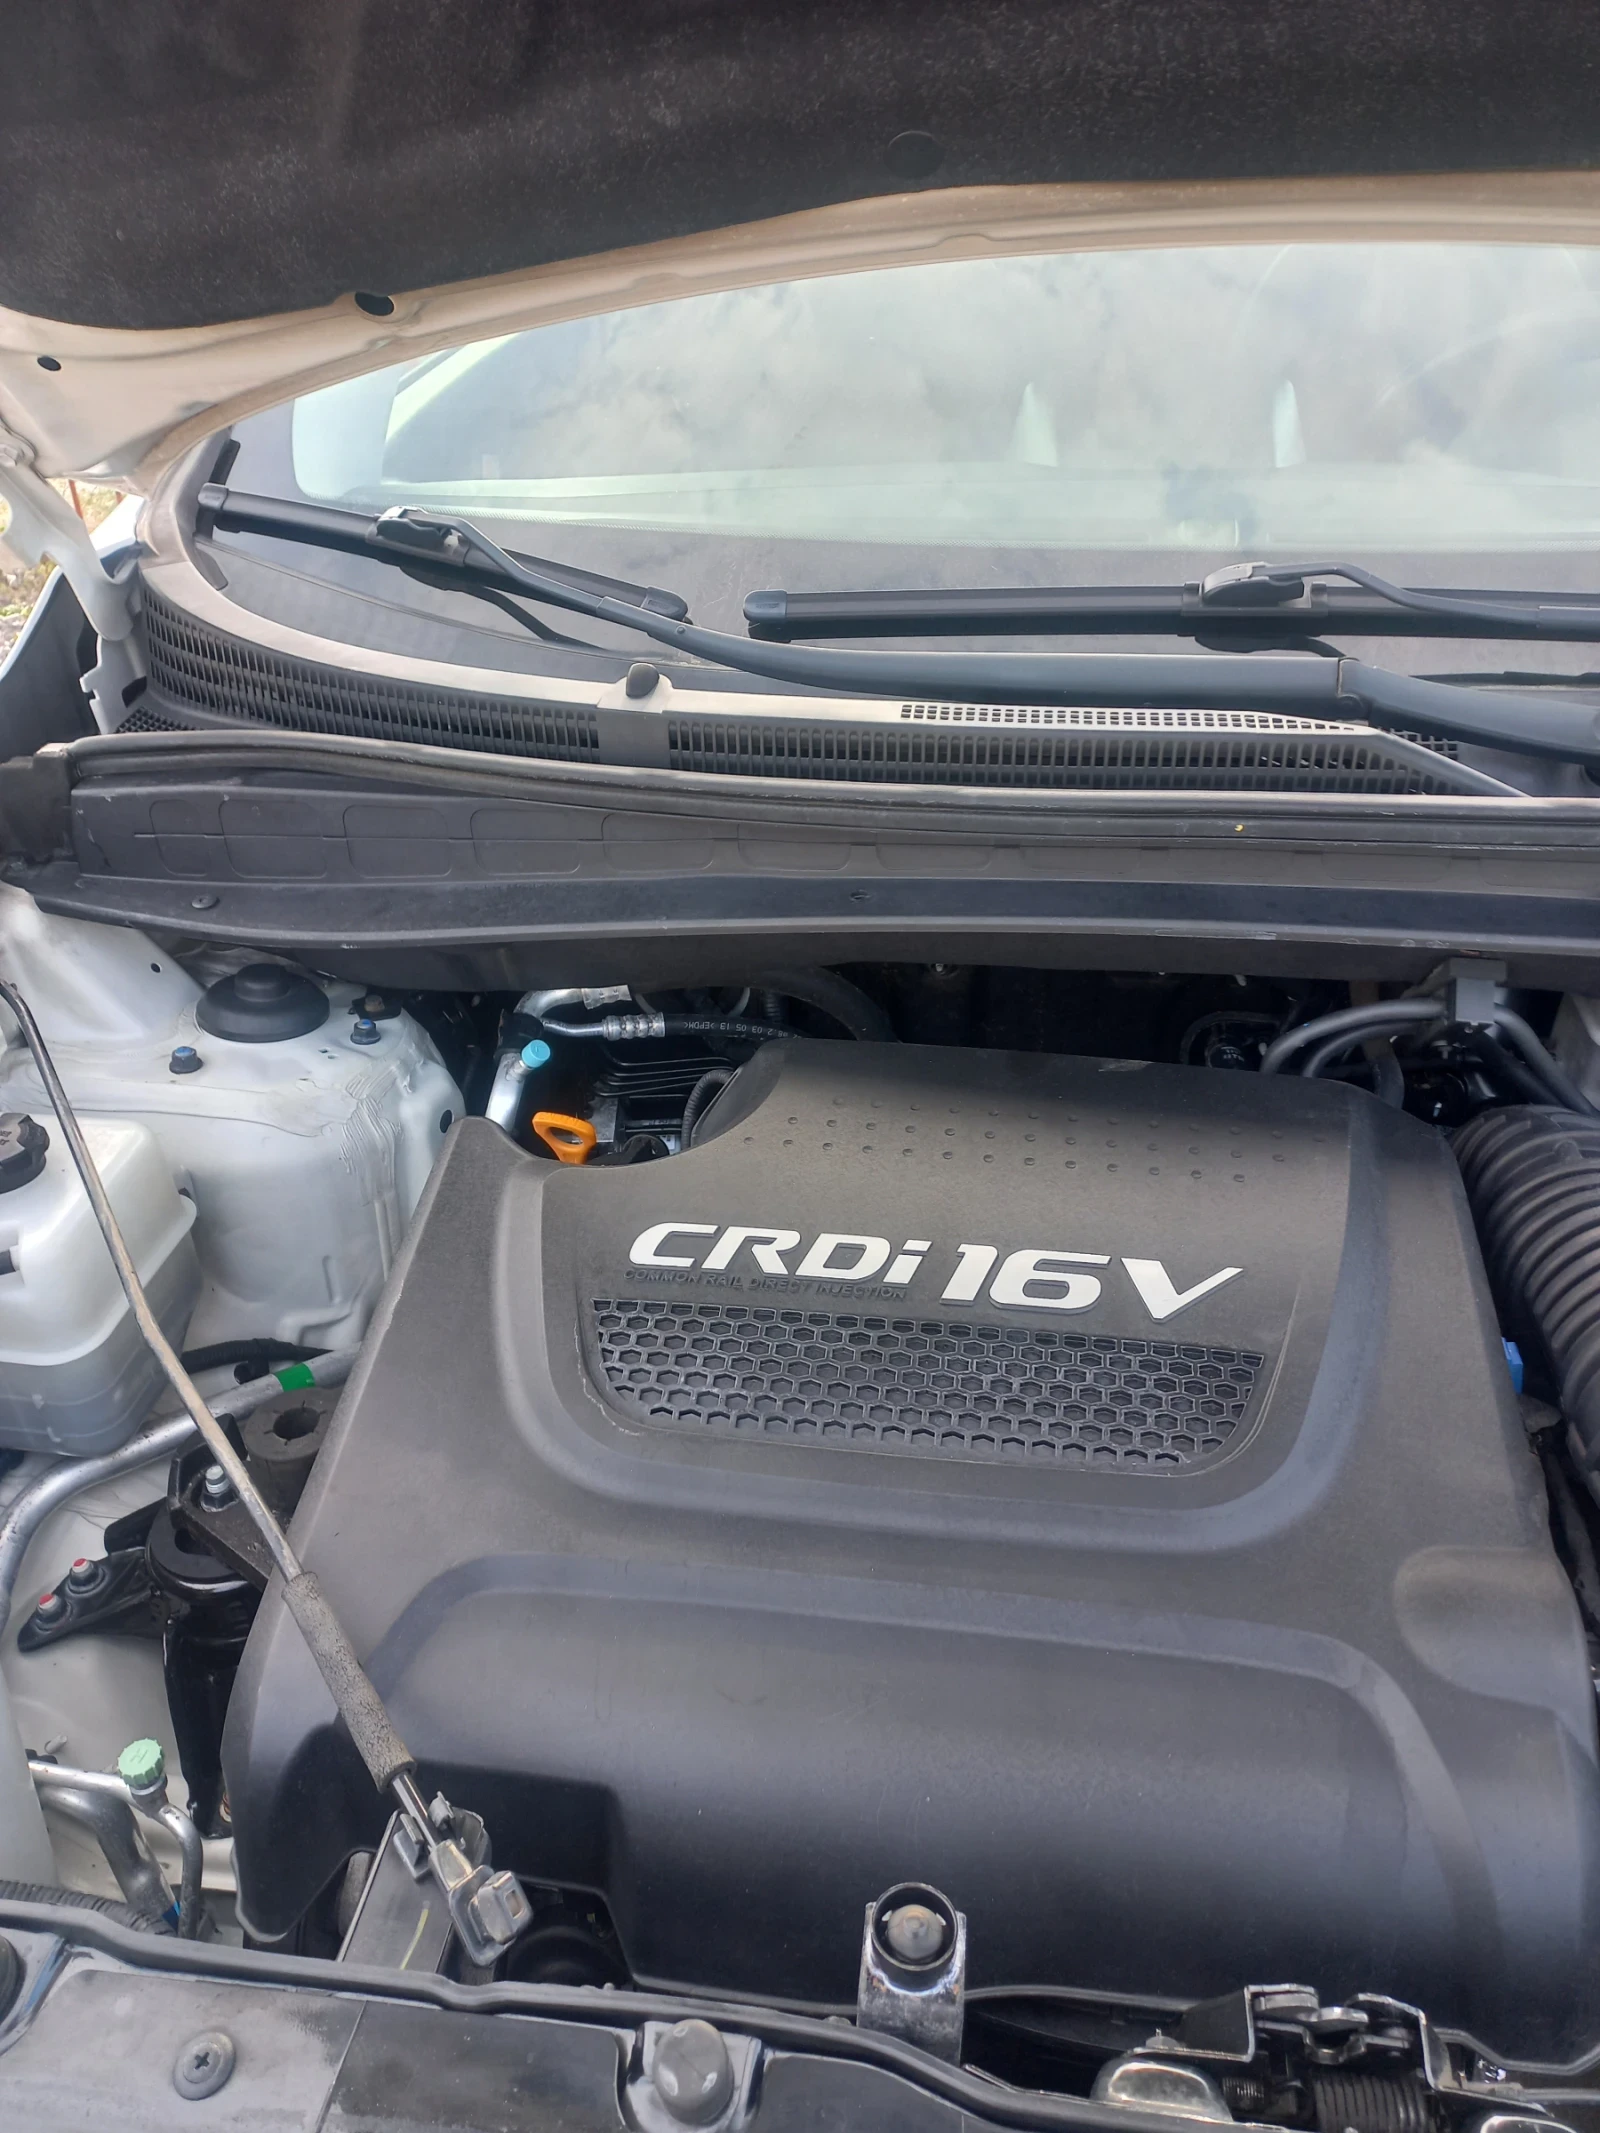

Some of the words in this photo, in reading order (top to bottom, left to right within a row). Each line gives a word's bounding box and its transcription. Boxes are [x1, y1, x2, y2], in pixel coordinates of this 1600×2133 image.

[719, 1022, 730, 1031] 13
[735, 1023, 747, 1032] 05
[751, 1025, 763, 1034] 03
[628, 1221, 933, 1285] CRDi
[623, 1267, 702, 1284] COMMON
[703, 1274, 744, 1289] RAIL
[748, 1277, 811, 1293] DIRECT
[815, 1282, 909, 1300] INJECTION
